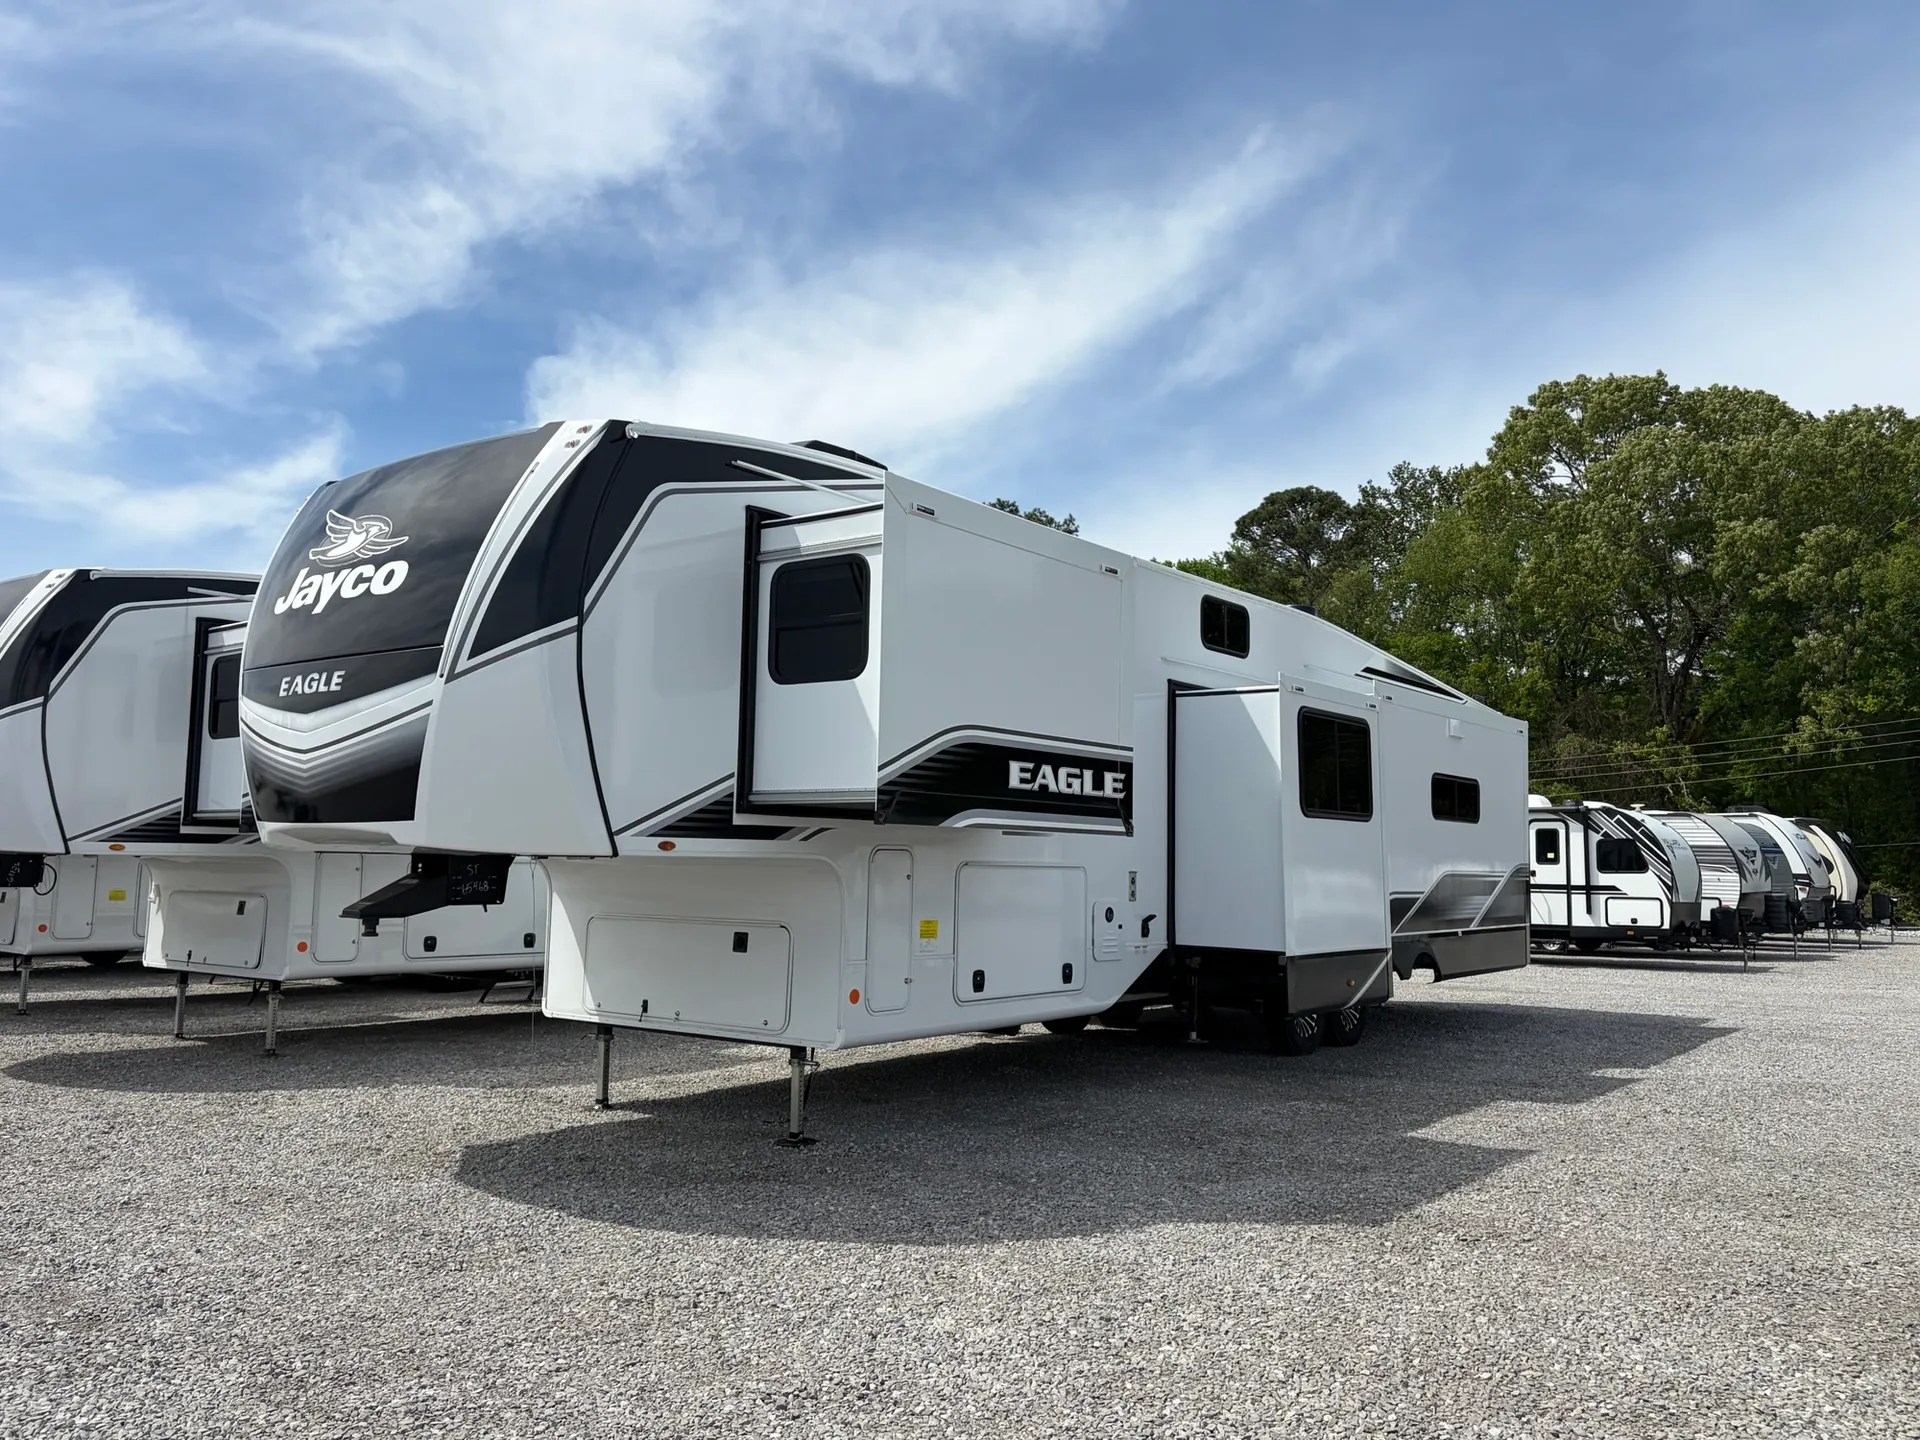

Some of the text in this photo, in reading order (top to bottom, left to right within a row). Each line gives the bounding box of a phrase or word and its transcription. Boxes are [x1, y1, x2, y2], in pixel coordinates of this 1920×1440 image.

[273, 560, 410, 615] Jayco
[278, 670, 346, 698] EAGLE
[1008, 760, 1127, 799] EAGLE
